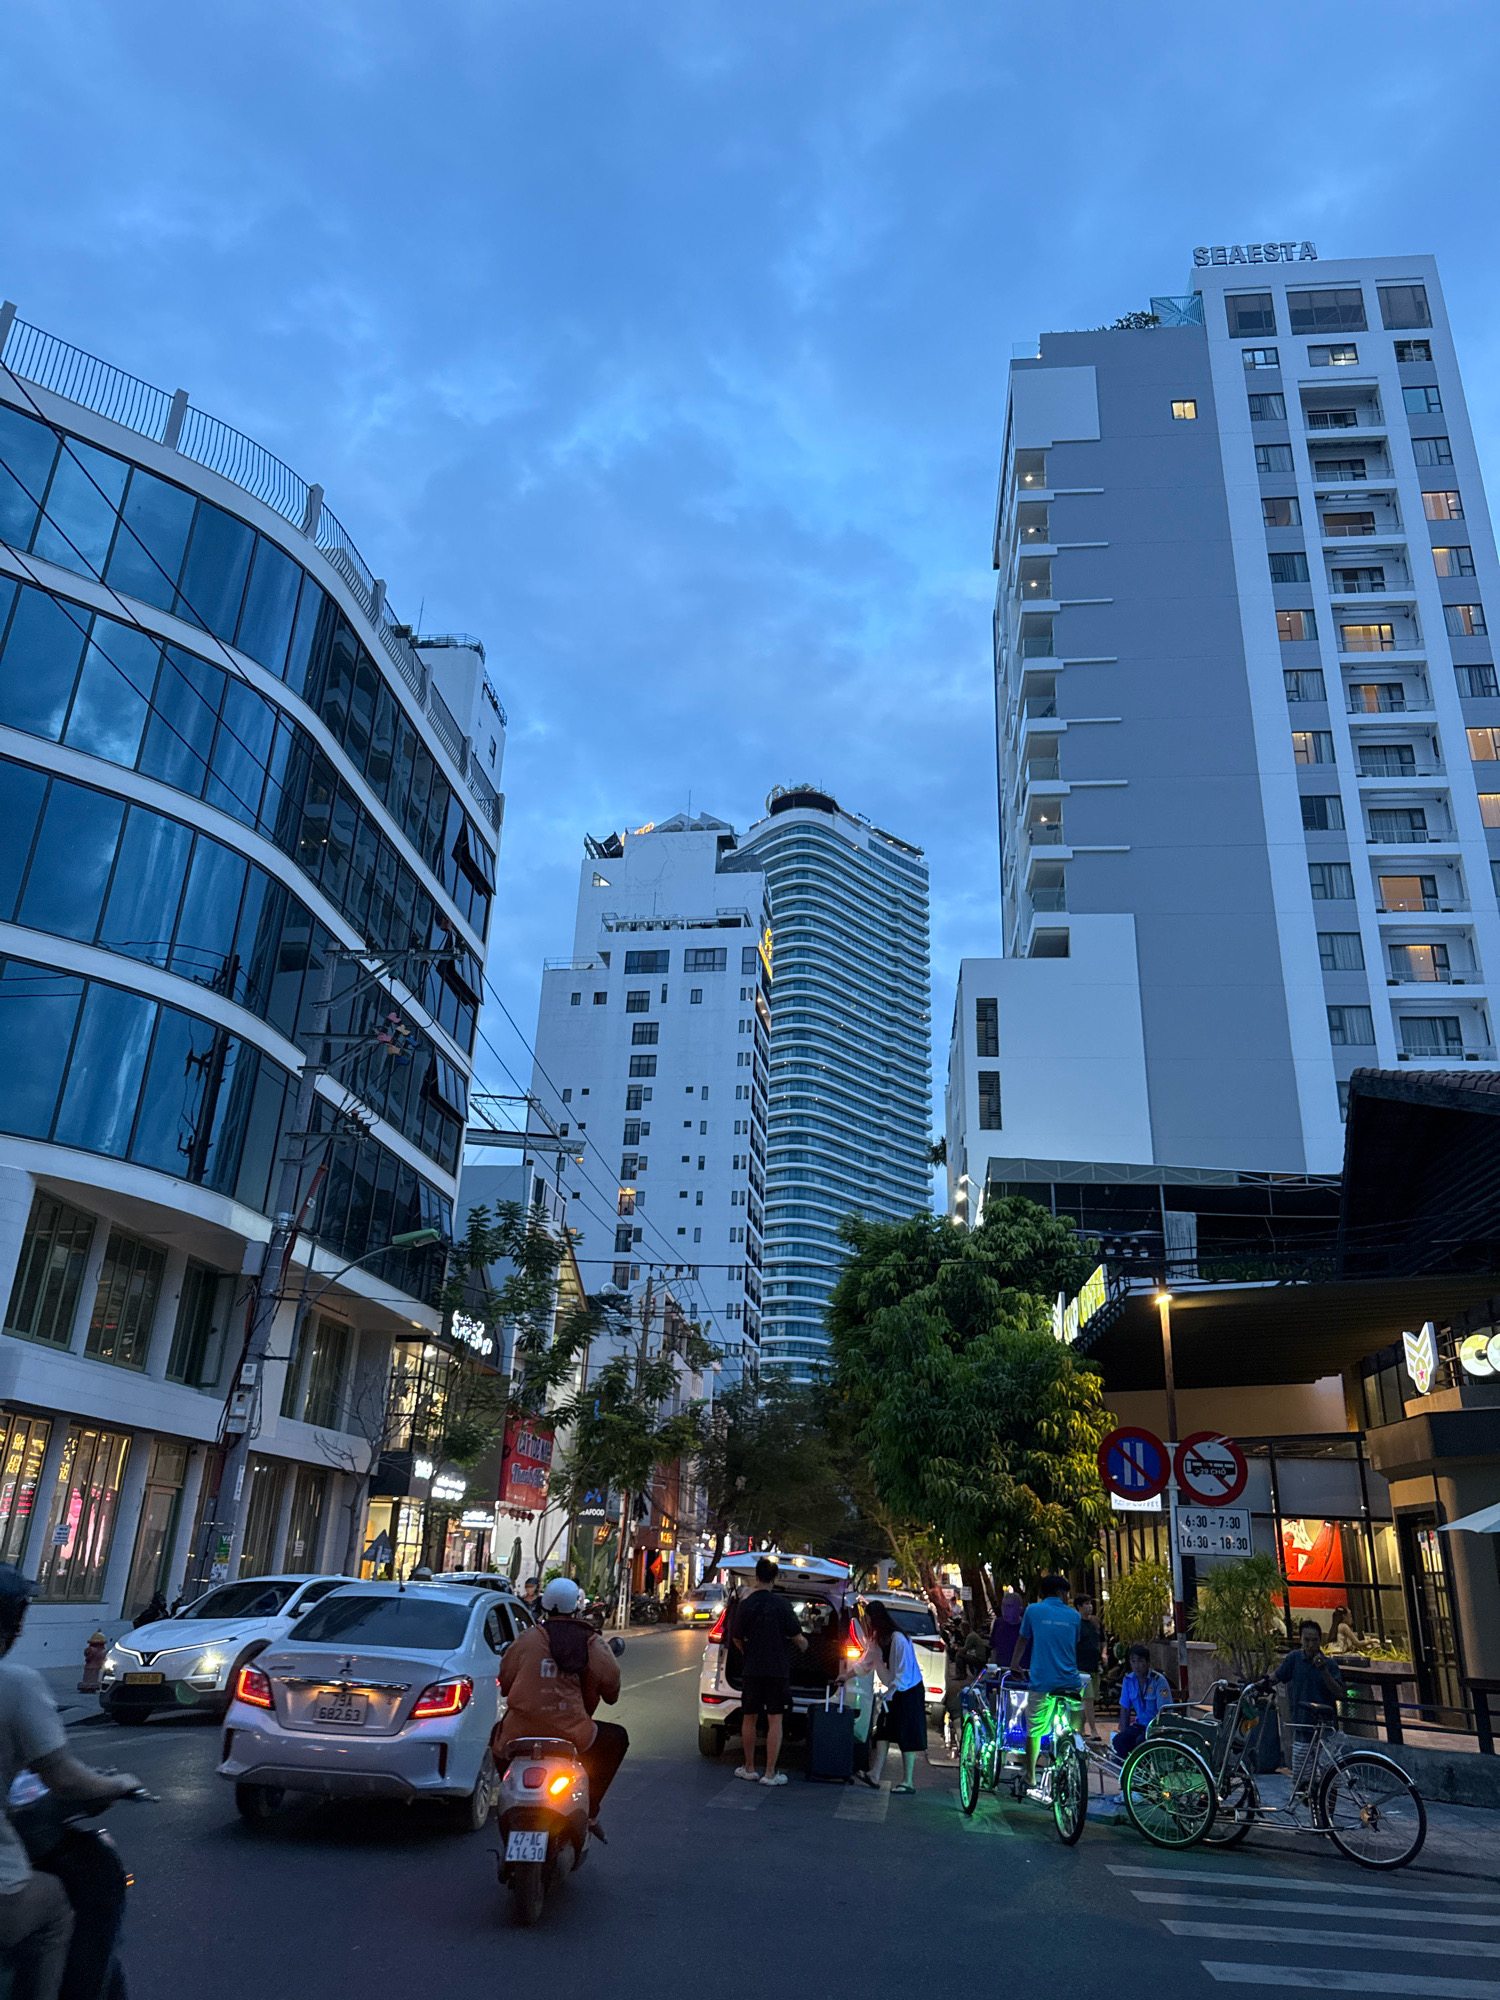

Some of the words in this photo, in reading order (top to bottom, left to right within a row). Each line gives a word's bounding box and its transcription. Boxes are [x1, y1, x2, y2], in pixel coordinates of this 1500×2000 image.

[1193, 241, 1318, 266] SEAESTA
[1185, 1515, 1207, 1528] 6:30
[1219, 1516, 1240, 1529] 7:30
[1181, 1535, 1208, 1548] 16:30
[1221, 1537, 1248, 1550] 18:30
[332, 1694, 353, 1707] 79A
[319, 1707, 361, 1721] 682.63
[514, 1832, 542, 1846] 47-AC
